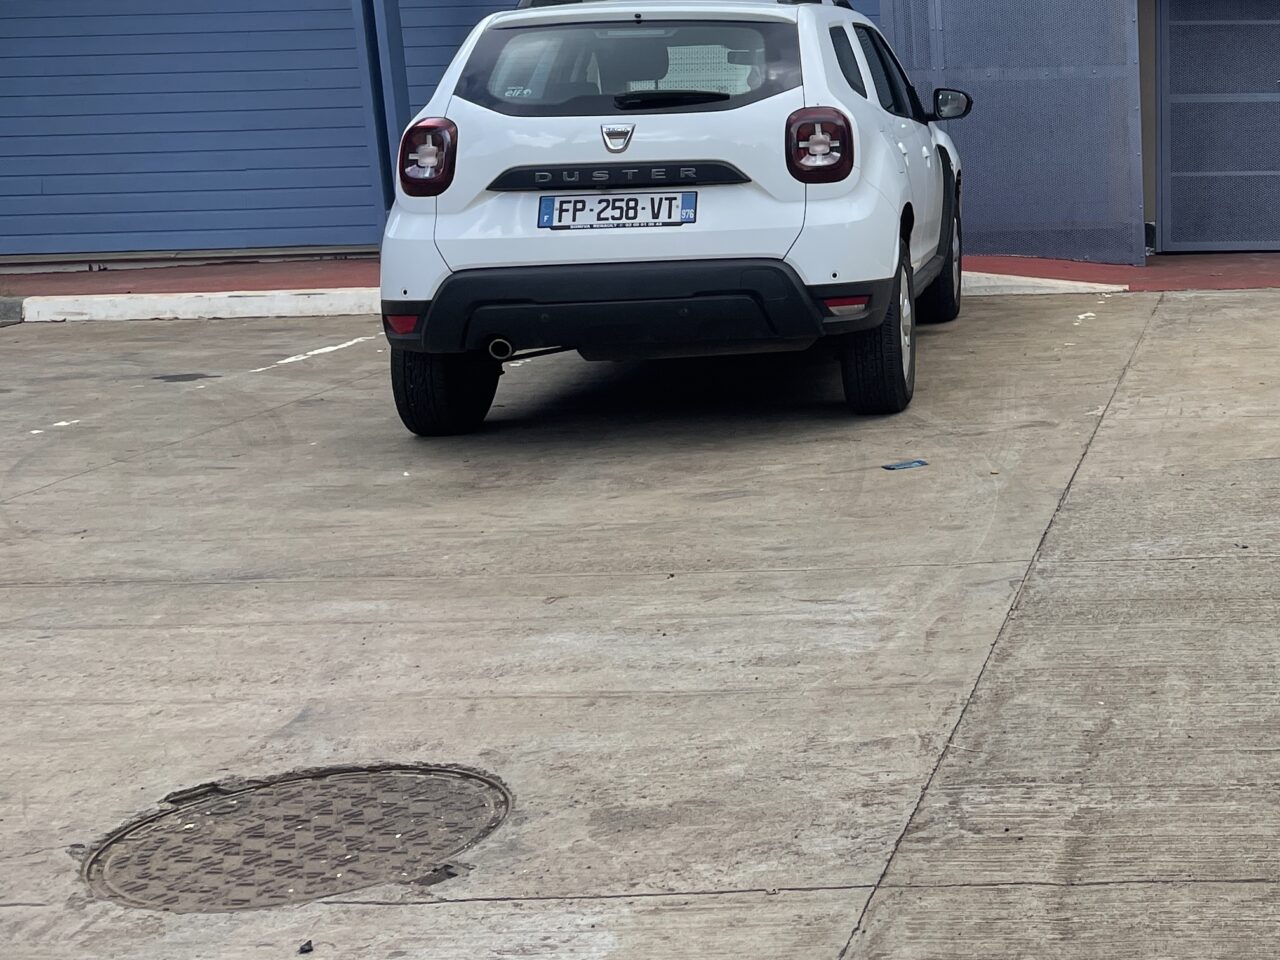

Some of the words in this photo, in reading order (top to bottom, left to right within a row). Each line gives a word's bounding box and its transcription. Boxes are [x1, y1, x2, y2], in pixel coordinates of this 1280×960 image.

[535, 167, 697, 183] DUSTER
[543, 215, 550, 223] F
[557, 196, 678, 223] FP-258-VT
[681, 209, 695, 220] 976
